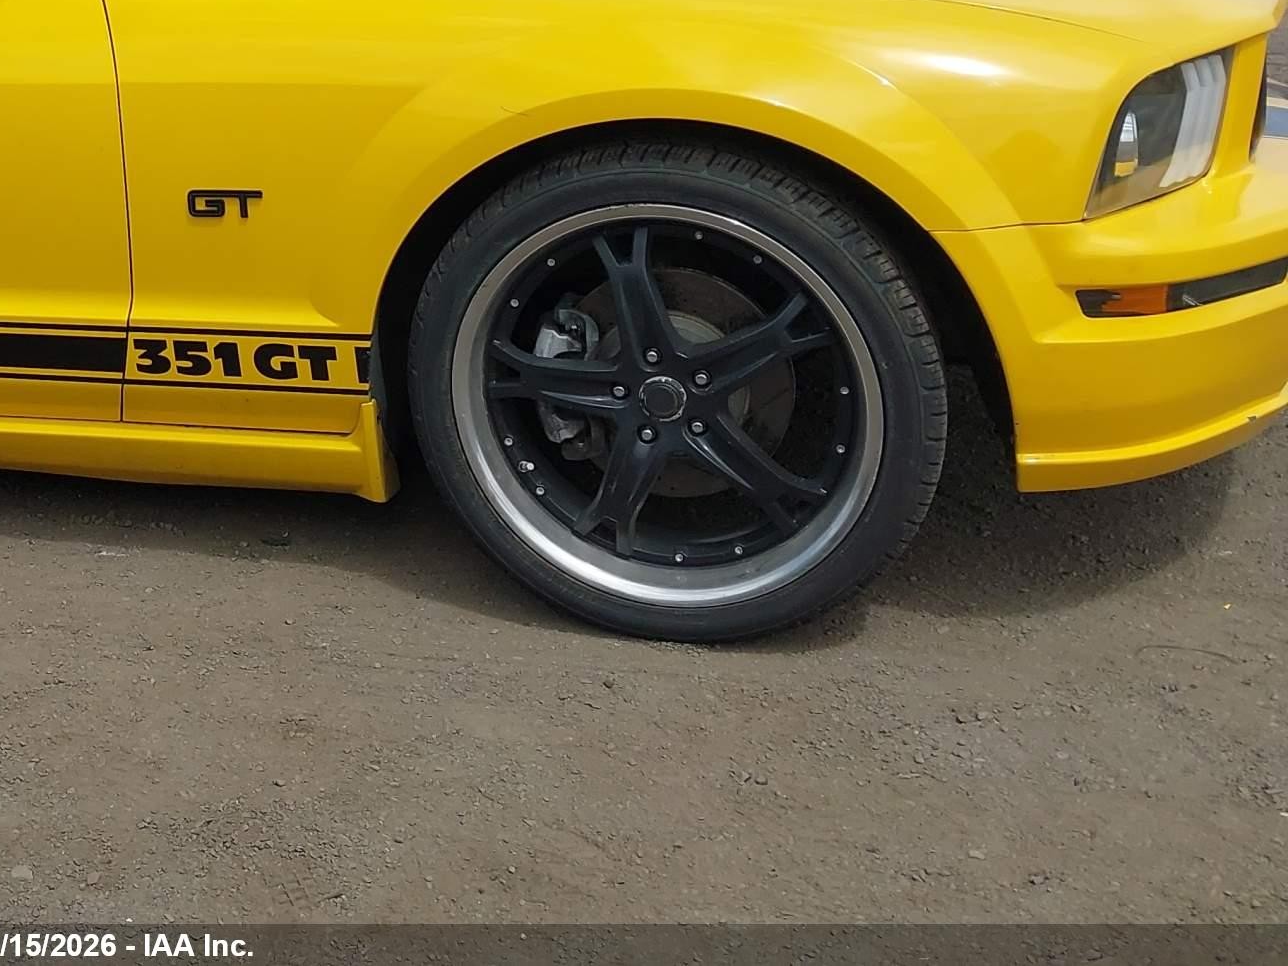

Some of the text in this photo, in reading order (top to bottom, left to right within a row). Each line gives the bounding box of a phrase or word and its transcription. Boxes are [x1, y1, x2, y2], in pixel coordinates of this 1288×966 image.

[187, 190, 262, 218] GT
[133, 338, 242, 377] 351
[253, 343, 338, 381] GT
